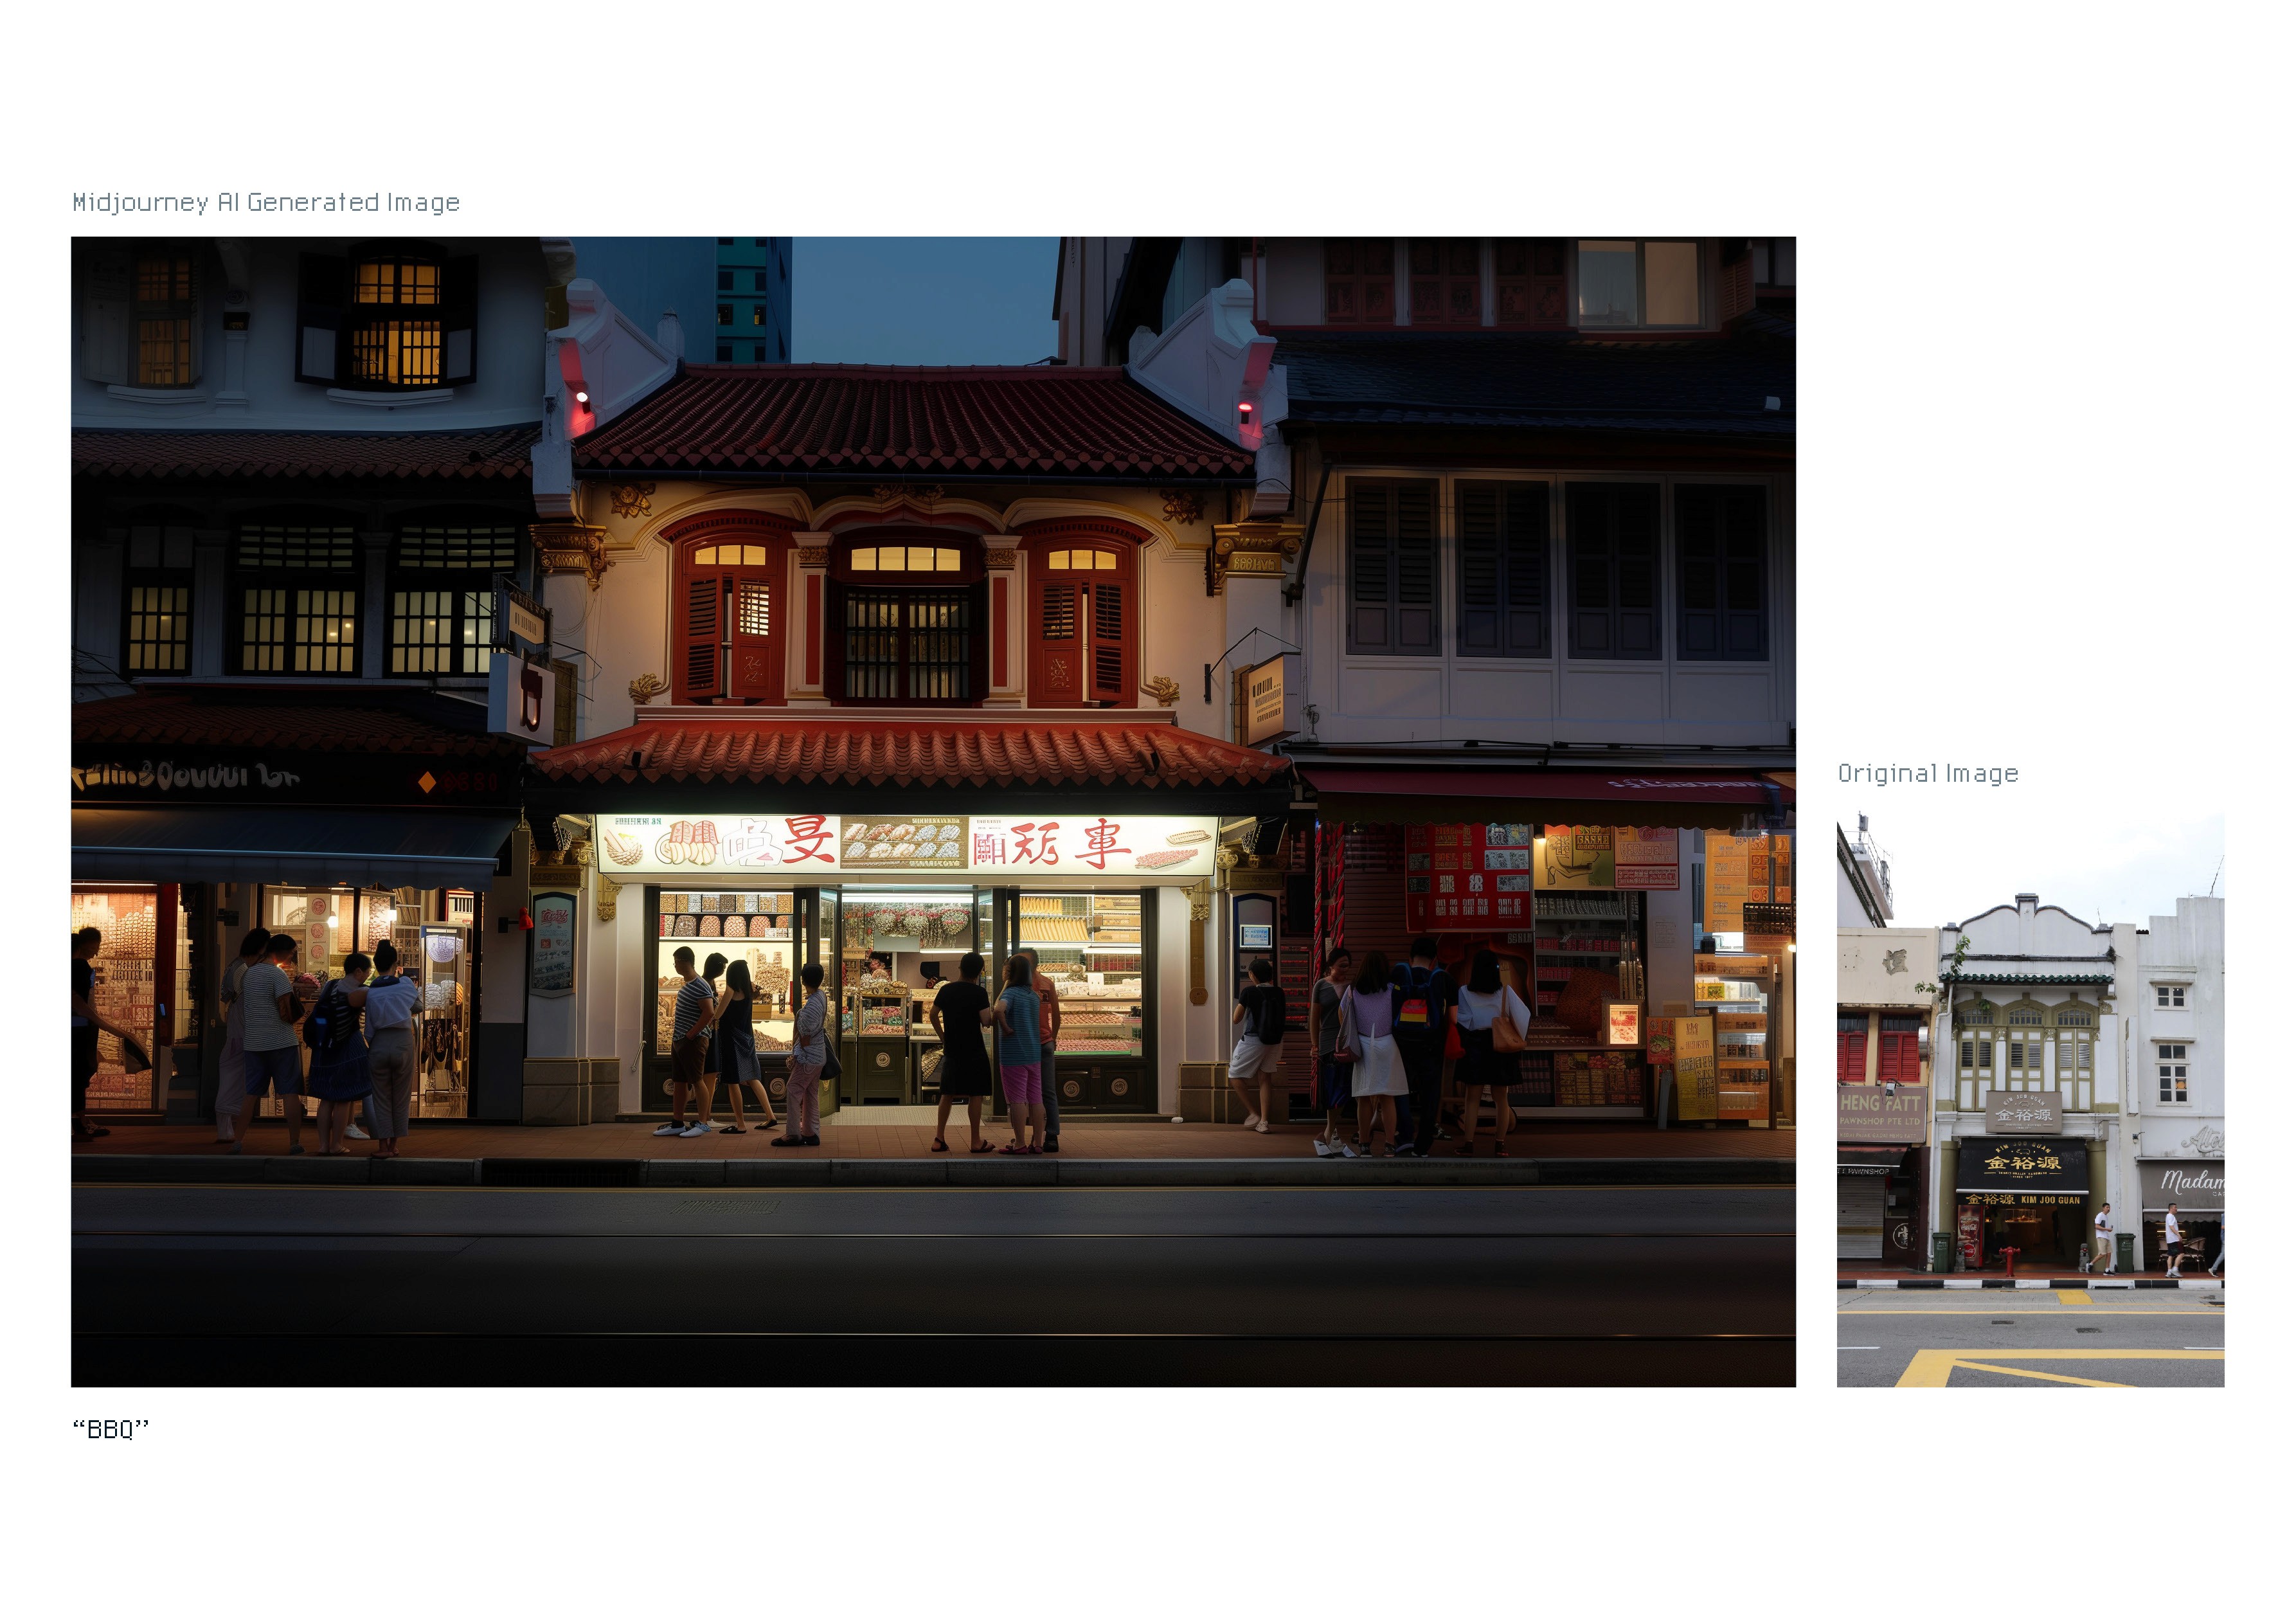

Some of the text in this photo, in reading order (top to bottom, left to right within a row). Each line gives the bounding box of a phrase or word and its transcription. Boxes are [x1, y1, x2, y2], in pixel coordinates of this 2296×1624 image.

[1840, 1094, 1921, 1112] HENG FATT
[2003, 1097, 2013, 1106] KIM
[2030, 1095, 2046, 1106] GUAN
[1995, 1108, 2054, 1121] 金裕源
[1840, 1117, 1885, 1125] PAWNSHOP
[1995, 1144, 2009, 1153] KIM
[2031, 1142, 2052, 1153] GUAN
[1984, 1155, 2062, 1170] 金裕源
[1966, 1194, 2016, 1205] 金裕源
[2038, 1196, 2056, 1204] JOO
